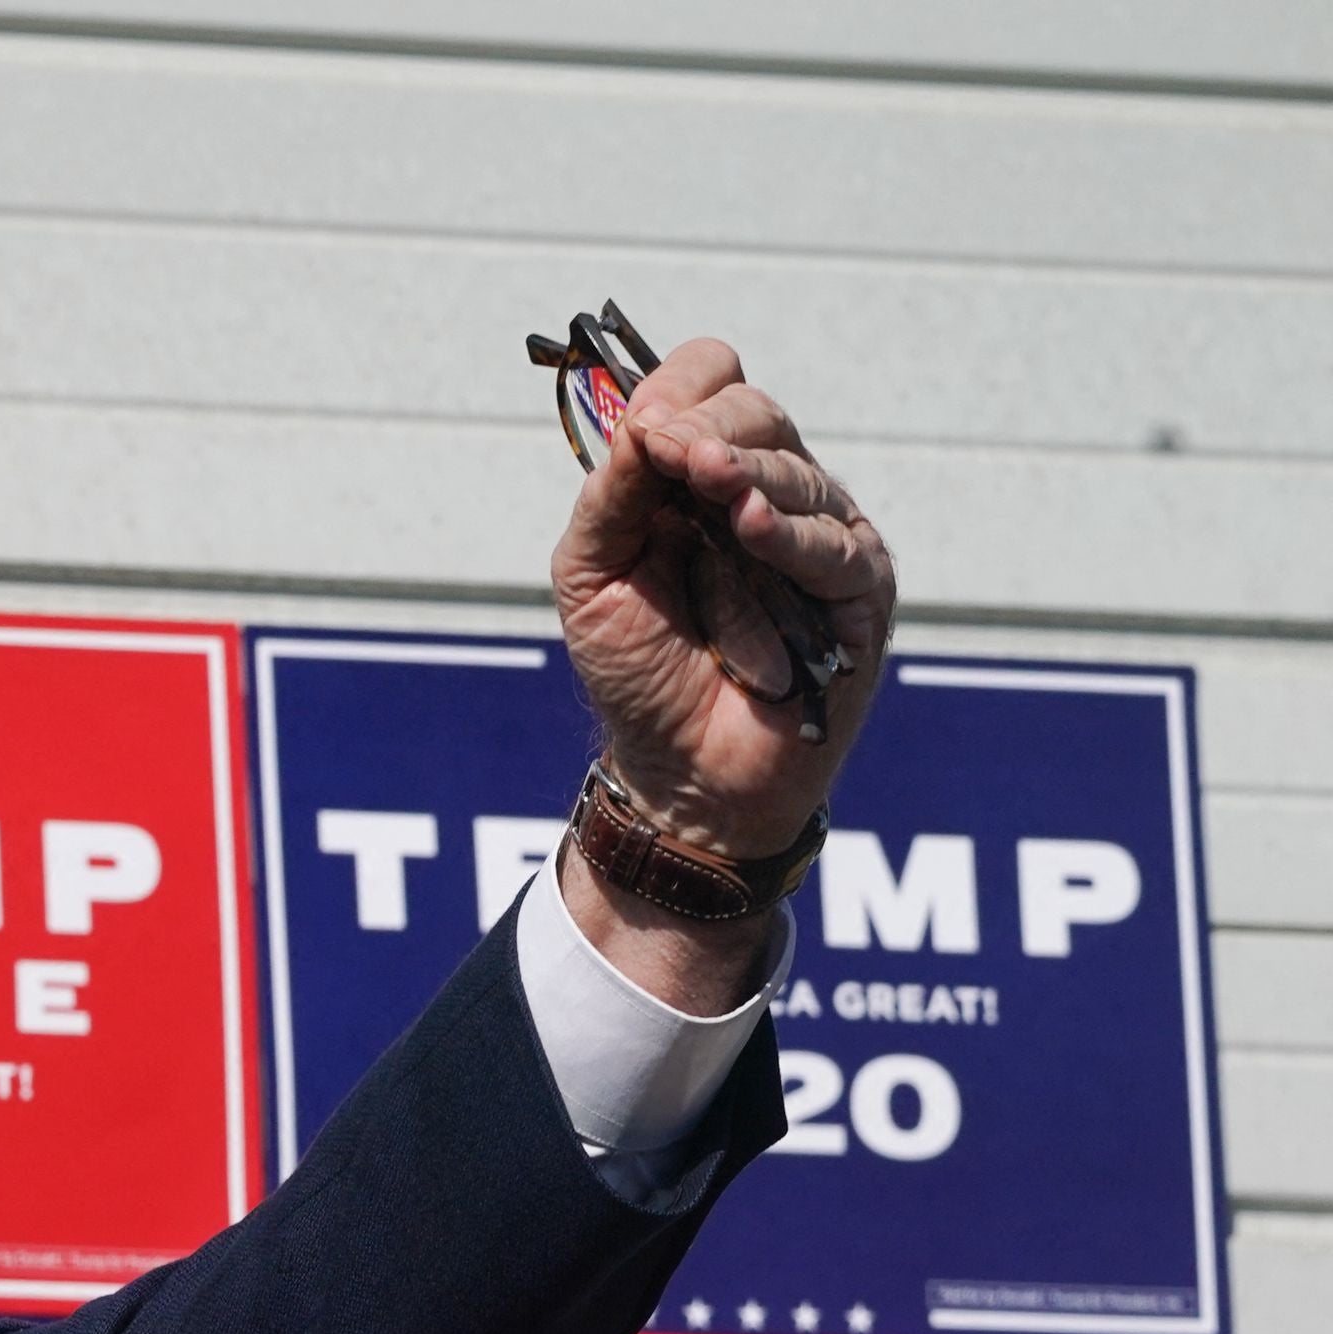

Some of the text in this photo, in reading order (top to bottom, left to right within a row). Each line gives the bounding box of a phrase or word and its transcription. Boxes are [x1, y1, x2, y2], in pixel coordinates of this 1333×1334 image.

[317, 809, 1143, 959] TMP
[833, 980, 999, 1026] GREAT!
[767, 1049, 963, 1162] 20
